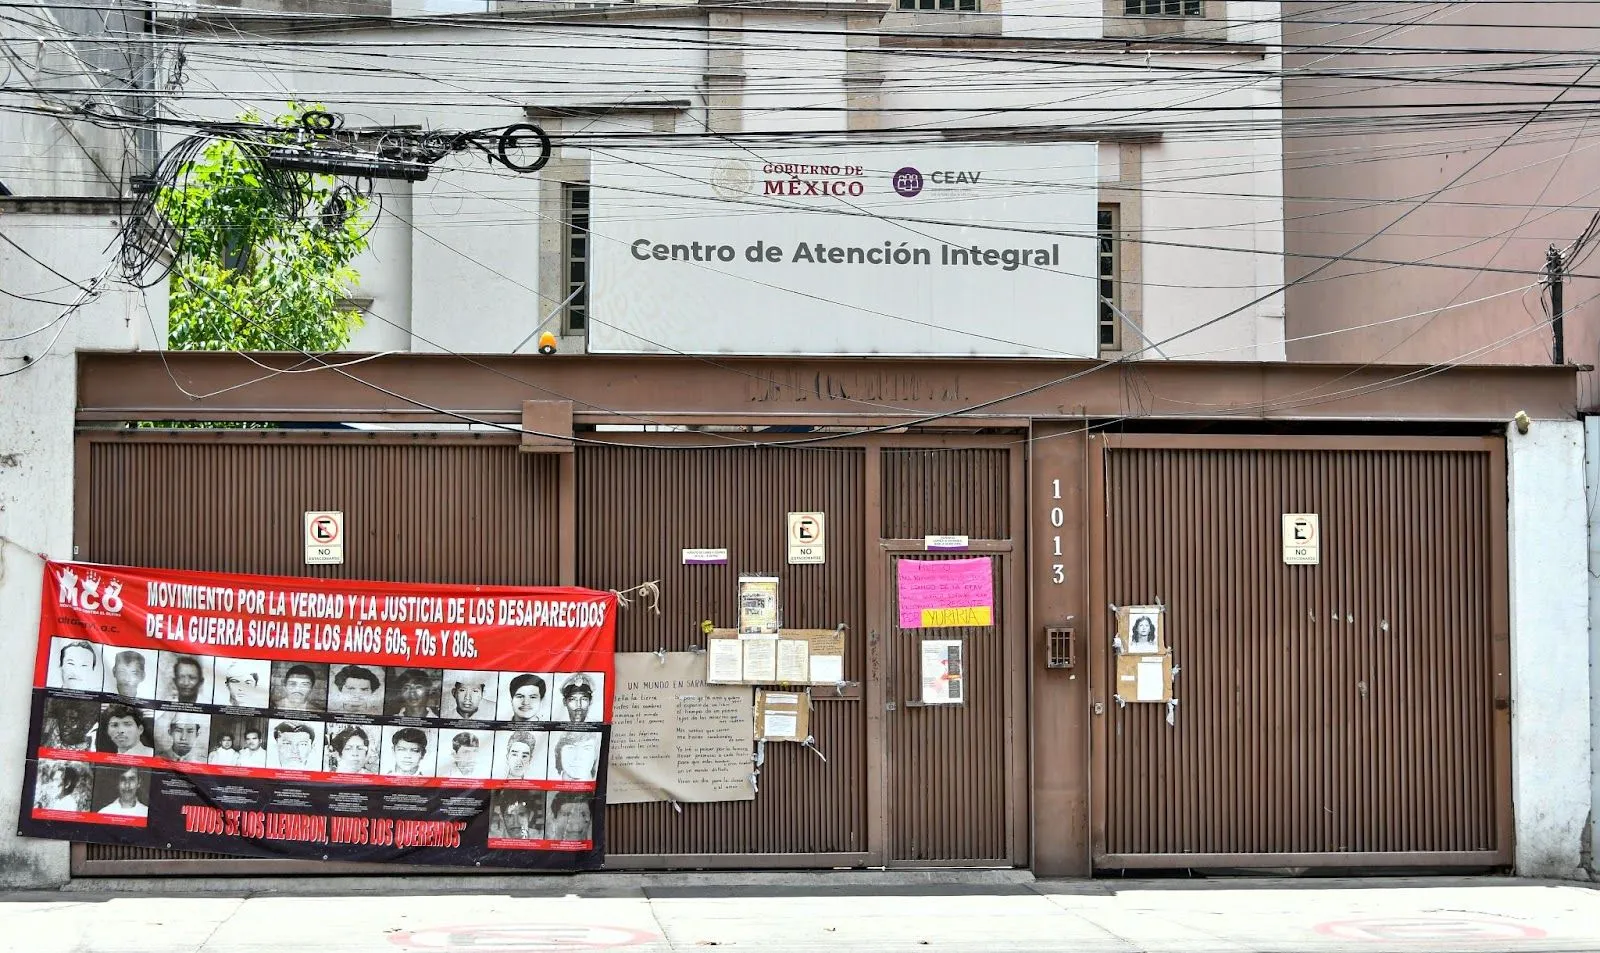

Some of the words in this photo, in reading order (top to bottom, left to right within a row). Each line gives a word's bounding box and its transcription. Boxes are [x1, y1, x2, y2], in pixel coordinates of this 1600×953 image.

[763, 164, 840, 176] GOBIERNO
[845, 165, 863, 176] DE
[763, 175, 864, 197] MÉXICO
[931, 171, 981, 184] CEAV
[631, 239, 736, 264] Centro
[744, 240, 783, 264] de
[792, 240, 932, 265] Atención
[941, 244, 1060, 272] Integral
[1051, 479, 1065, 584] 1013
[147, 581, 234, 612] MOVIMIENTO
[238, 589, 266, 614] POR
[269, 591, 286, 616] LA
[291, 592, 344, 619] VERDAD
[348, 594, 358, 620] Y
[360, 596, 377, 620] LA
[381, 596, 443, 623] JUSTICIA
[448, 598, 465, 624] DE
[469, 598, 495, 625] LOS
[498, 600, 606, 628] DESAPARECIDOS
[146, 613, 163, 639] DE
[167, 615, 184, 641] LA
[188, 616, 244, 646] GUERRA
[248, 619, 289, 648] SUCIA
[293, 622, 311, 650] DE
[314, 624, 340, 651] LOS
[344, 621, 382, 653] AÑOS
[385, 626, 411, 661] 60s,
[415, 628, 437, 656] 70s
[441, 630, 450, 656] Y
[452, 630, 478, 658] 80s.
[627, 682, 638, 690] UN
[643, 681, 669, 689] MUNDO
[225, 809, 240, 836] SE
[241, 811, 265, 839] LOS
[266, 812, 328, 845] LLEVARON,
[331, 816, 369, 845] VIVOS
[370, 818, 393, 846] LOS
